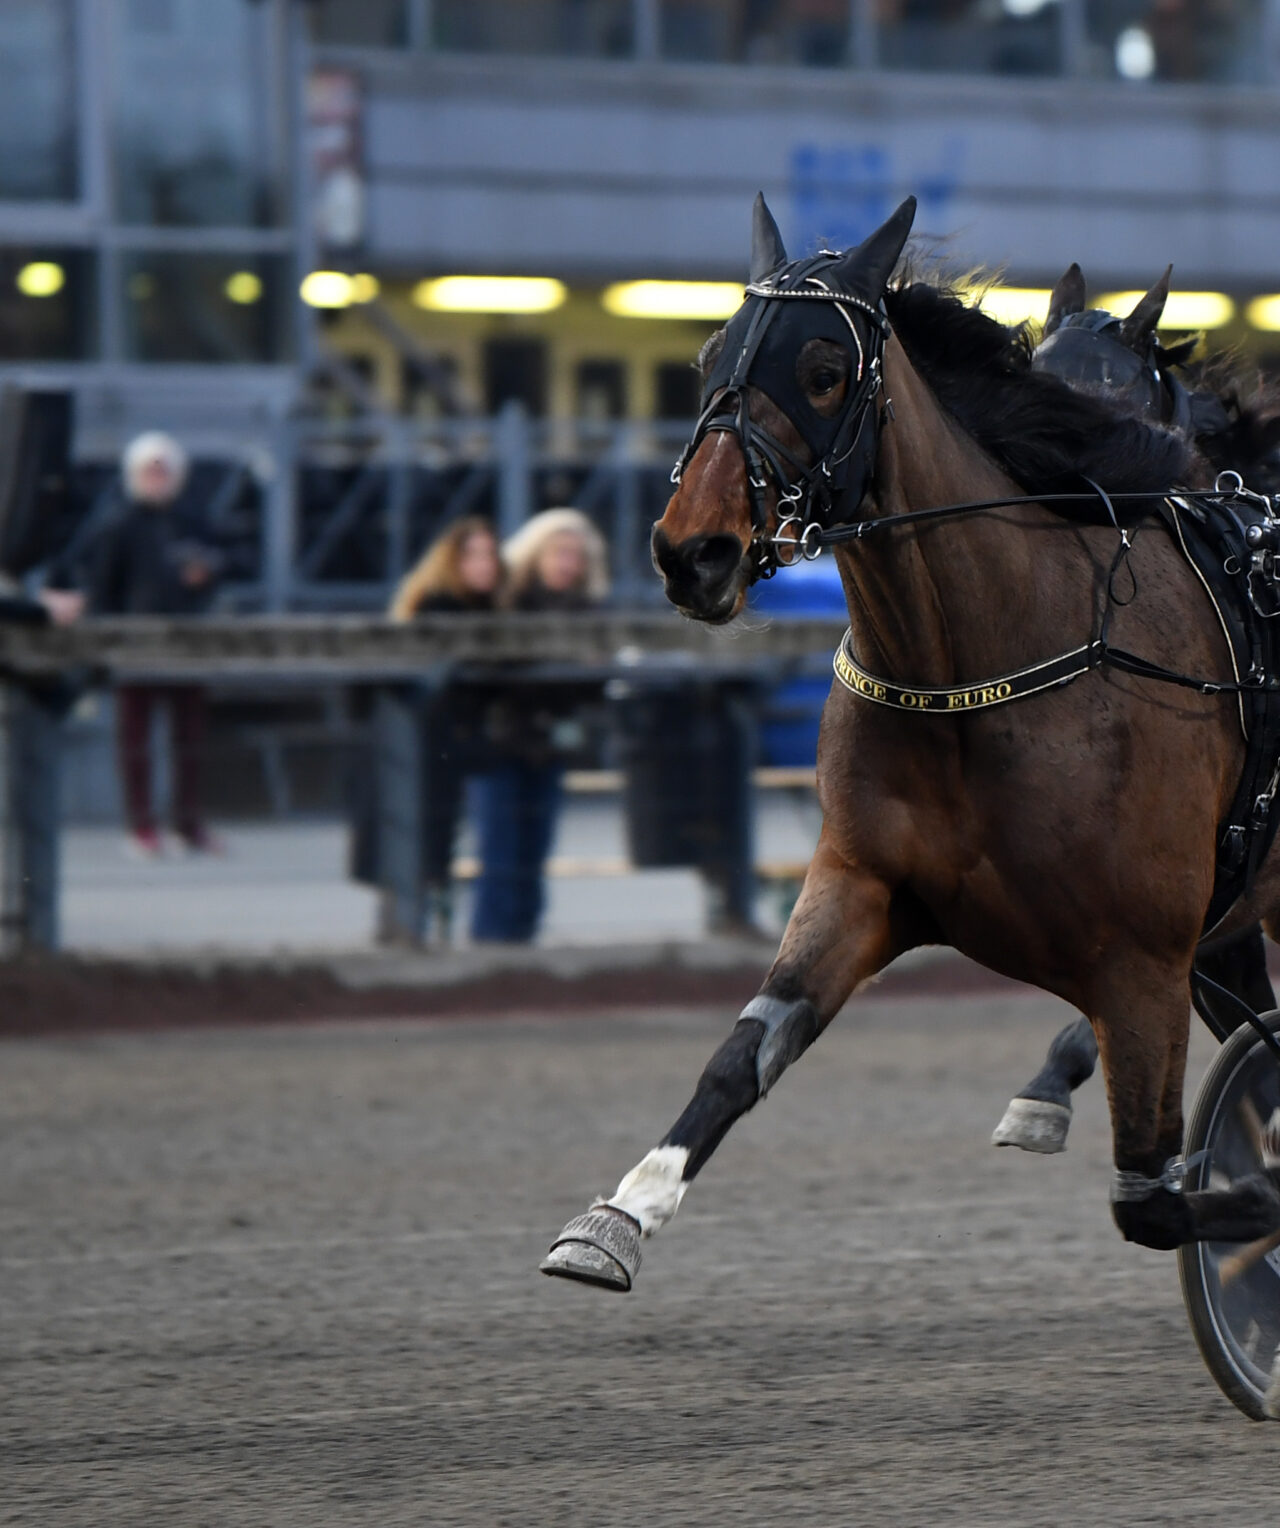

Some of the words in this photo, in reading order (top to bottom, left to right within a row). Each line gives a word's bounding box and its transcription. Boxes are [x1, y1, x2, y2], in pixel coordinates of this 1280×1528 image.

[836, 655, 887, 701] PRINCE
[899, 693, 932, 709] OF
[945, 682, 1012, 709] EURO
